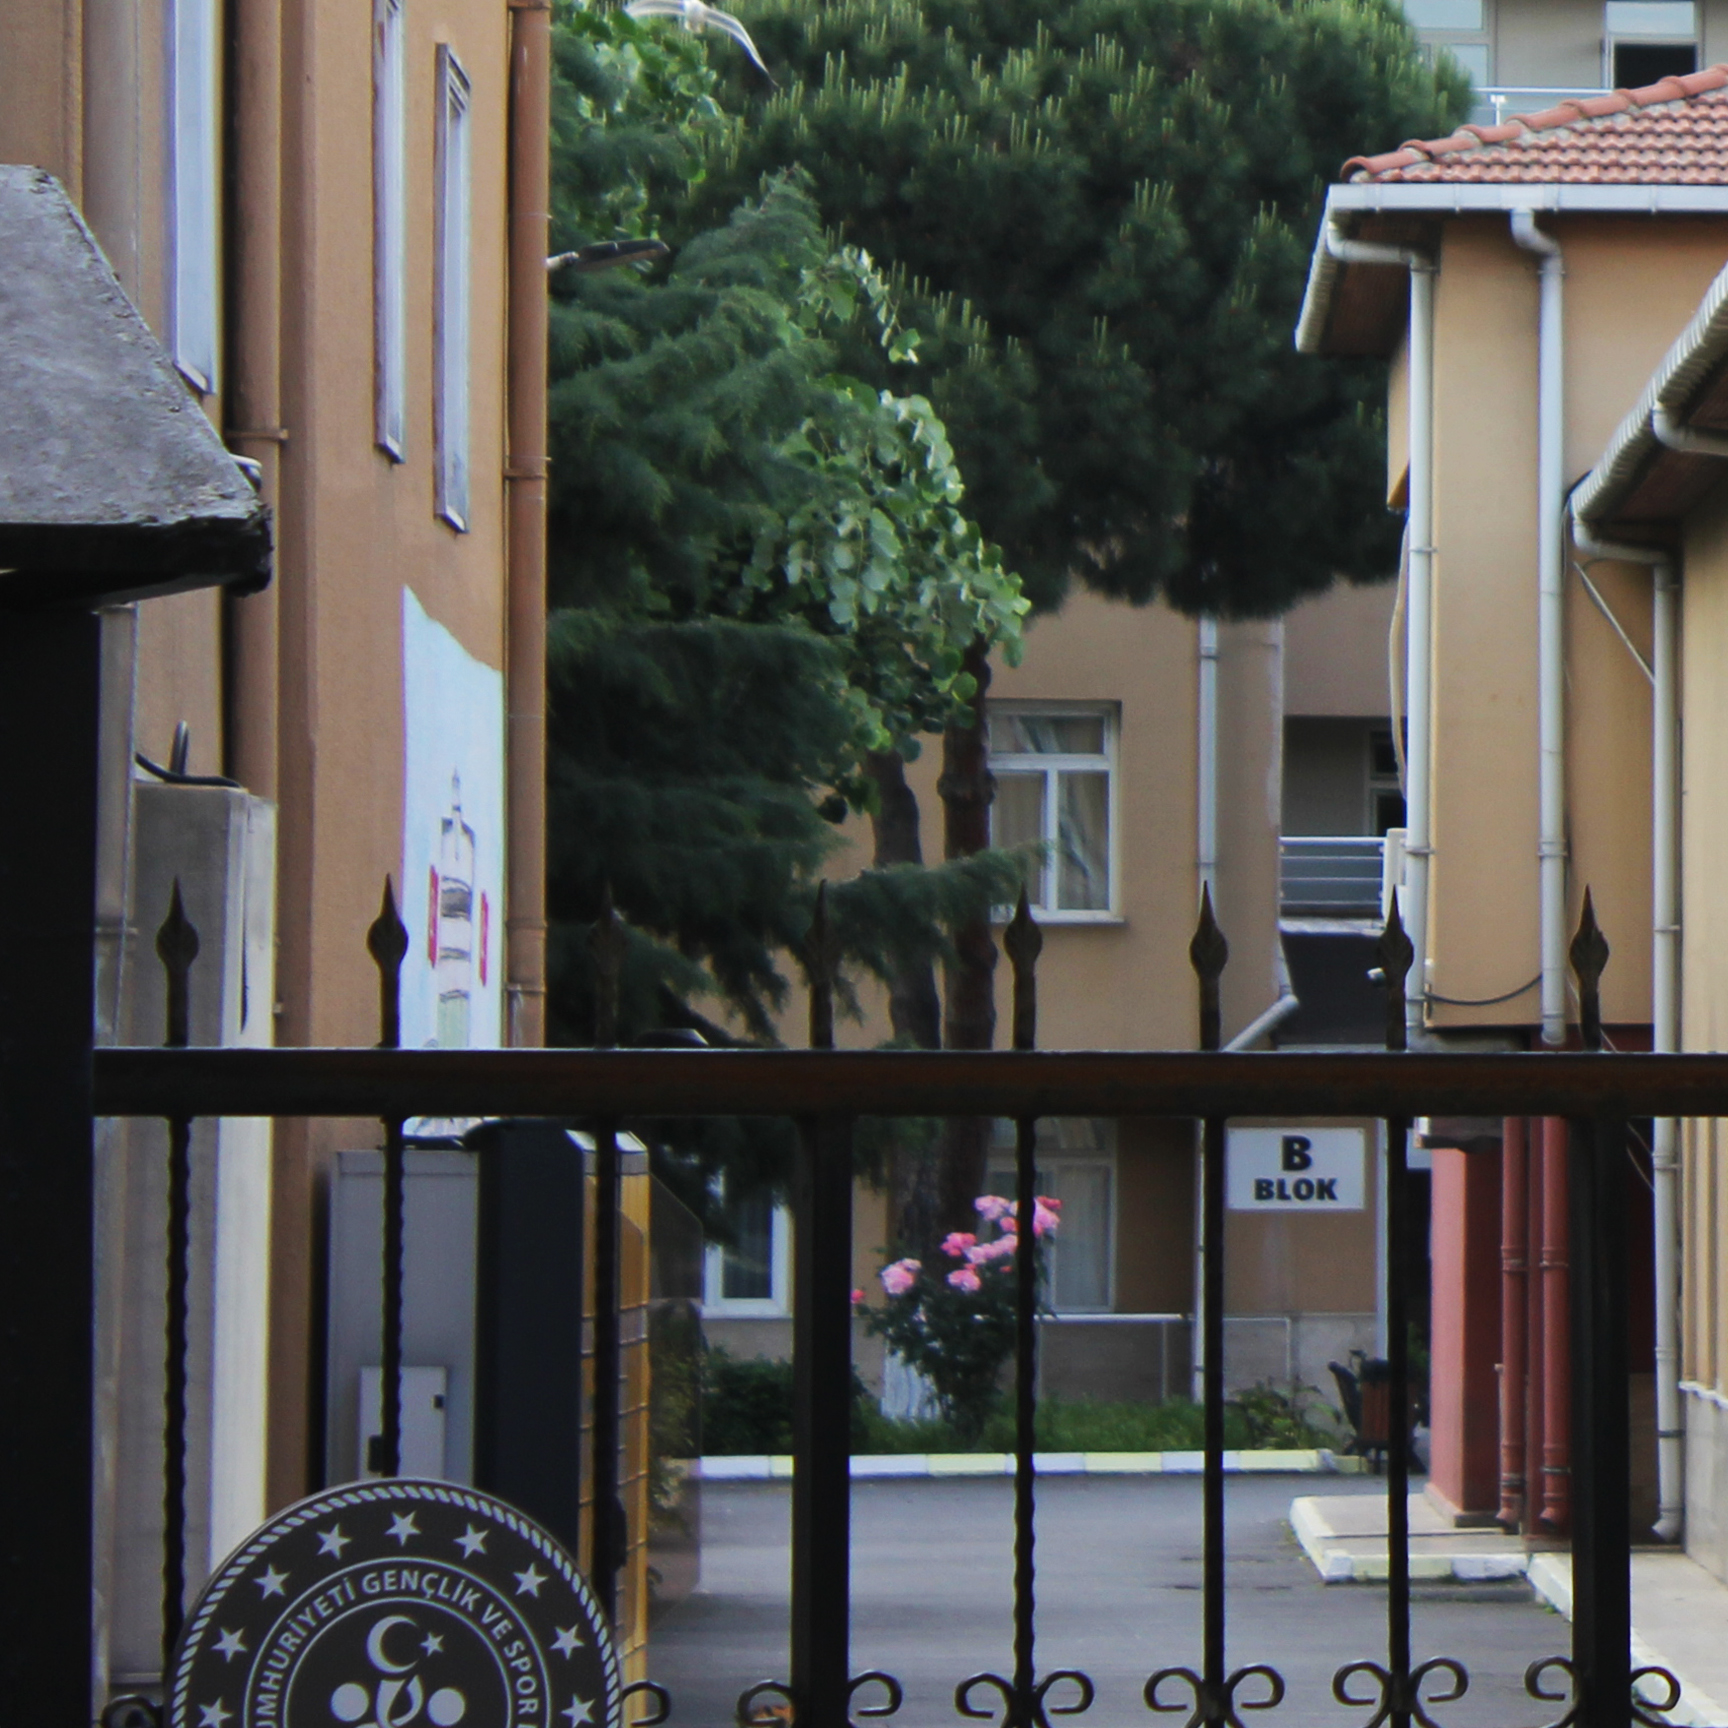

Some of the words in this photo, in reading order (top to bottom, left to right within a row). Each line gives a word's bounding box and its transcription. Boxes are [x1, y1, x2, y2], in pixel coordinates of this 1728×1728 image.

[1282, 1135, 1313, 1172] B
[1254, 1178, 1339, 1201] BLOK
[255, 1576, 356, 1728] MHURİYETİ
[361, 1569, 481, 1612] GENÇLİK
[481, 1603, 513, 1642] VE
[503, 1639, 539, 1716] SPOR
